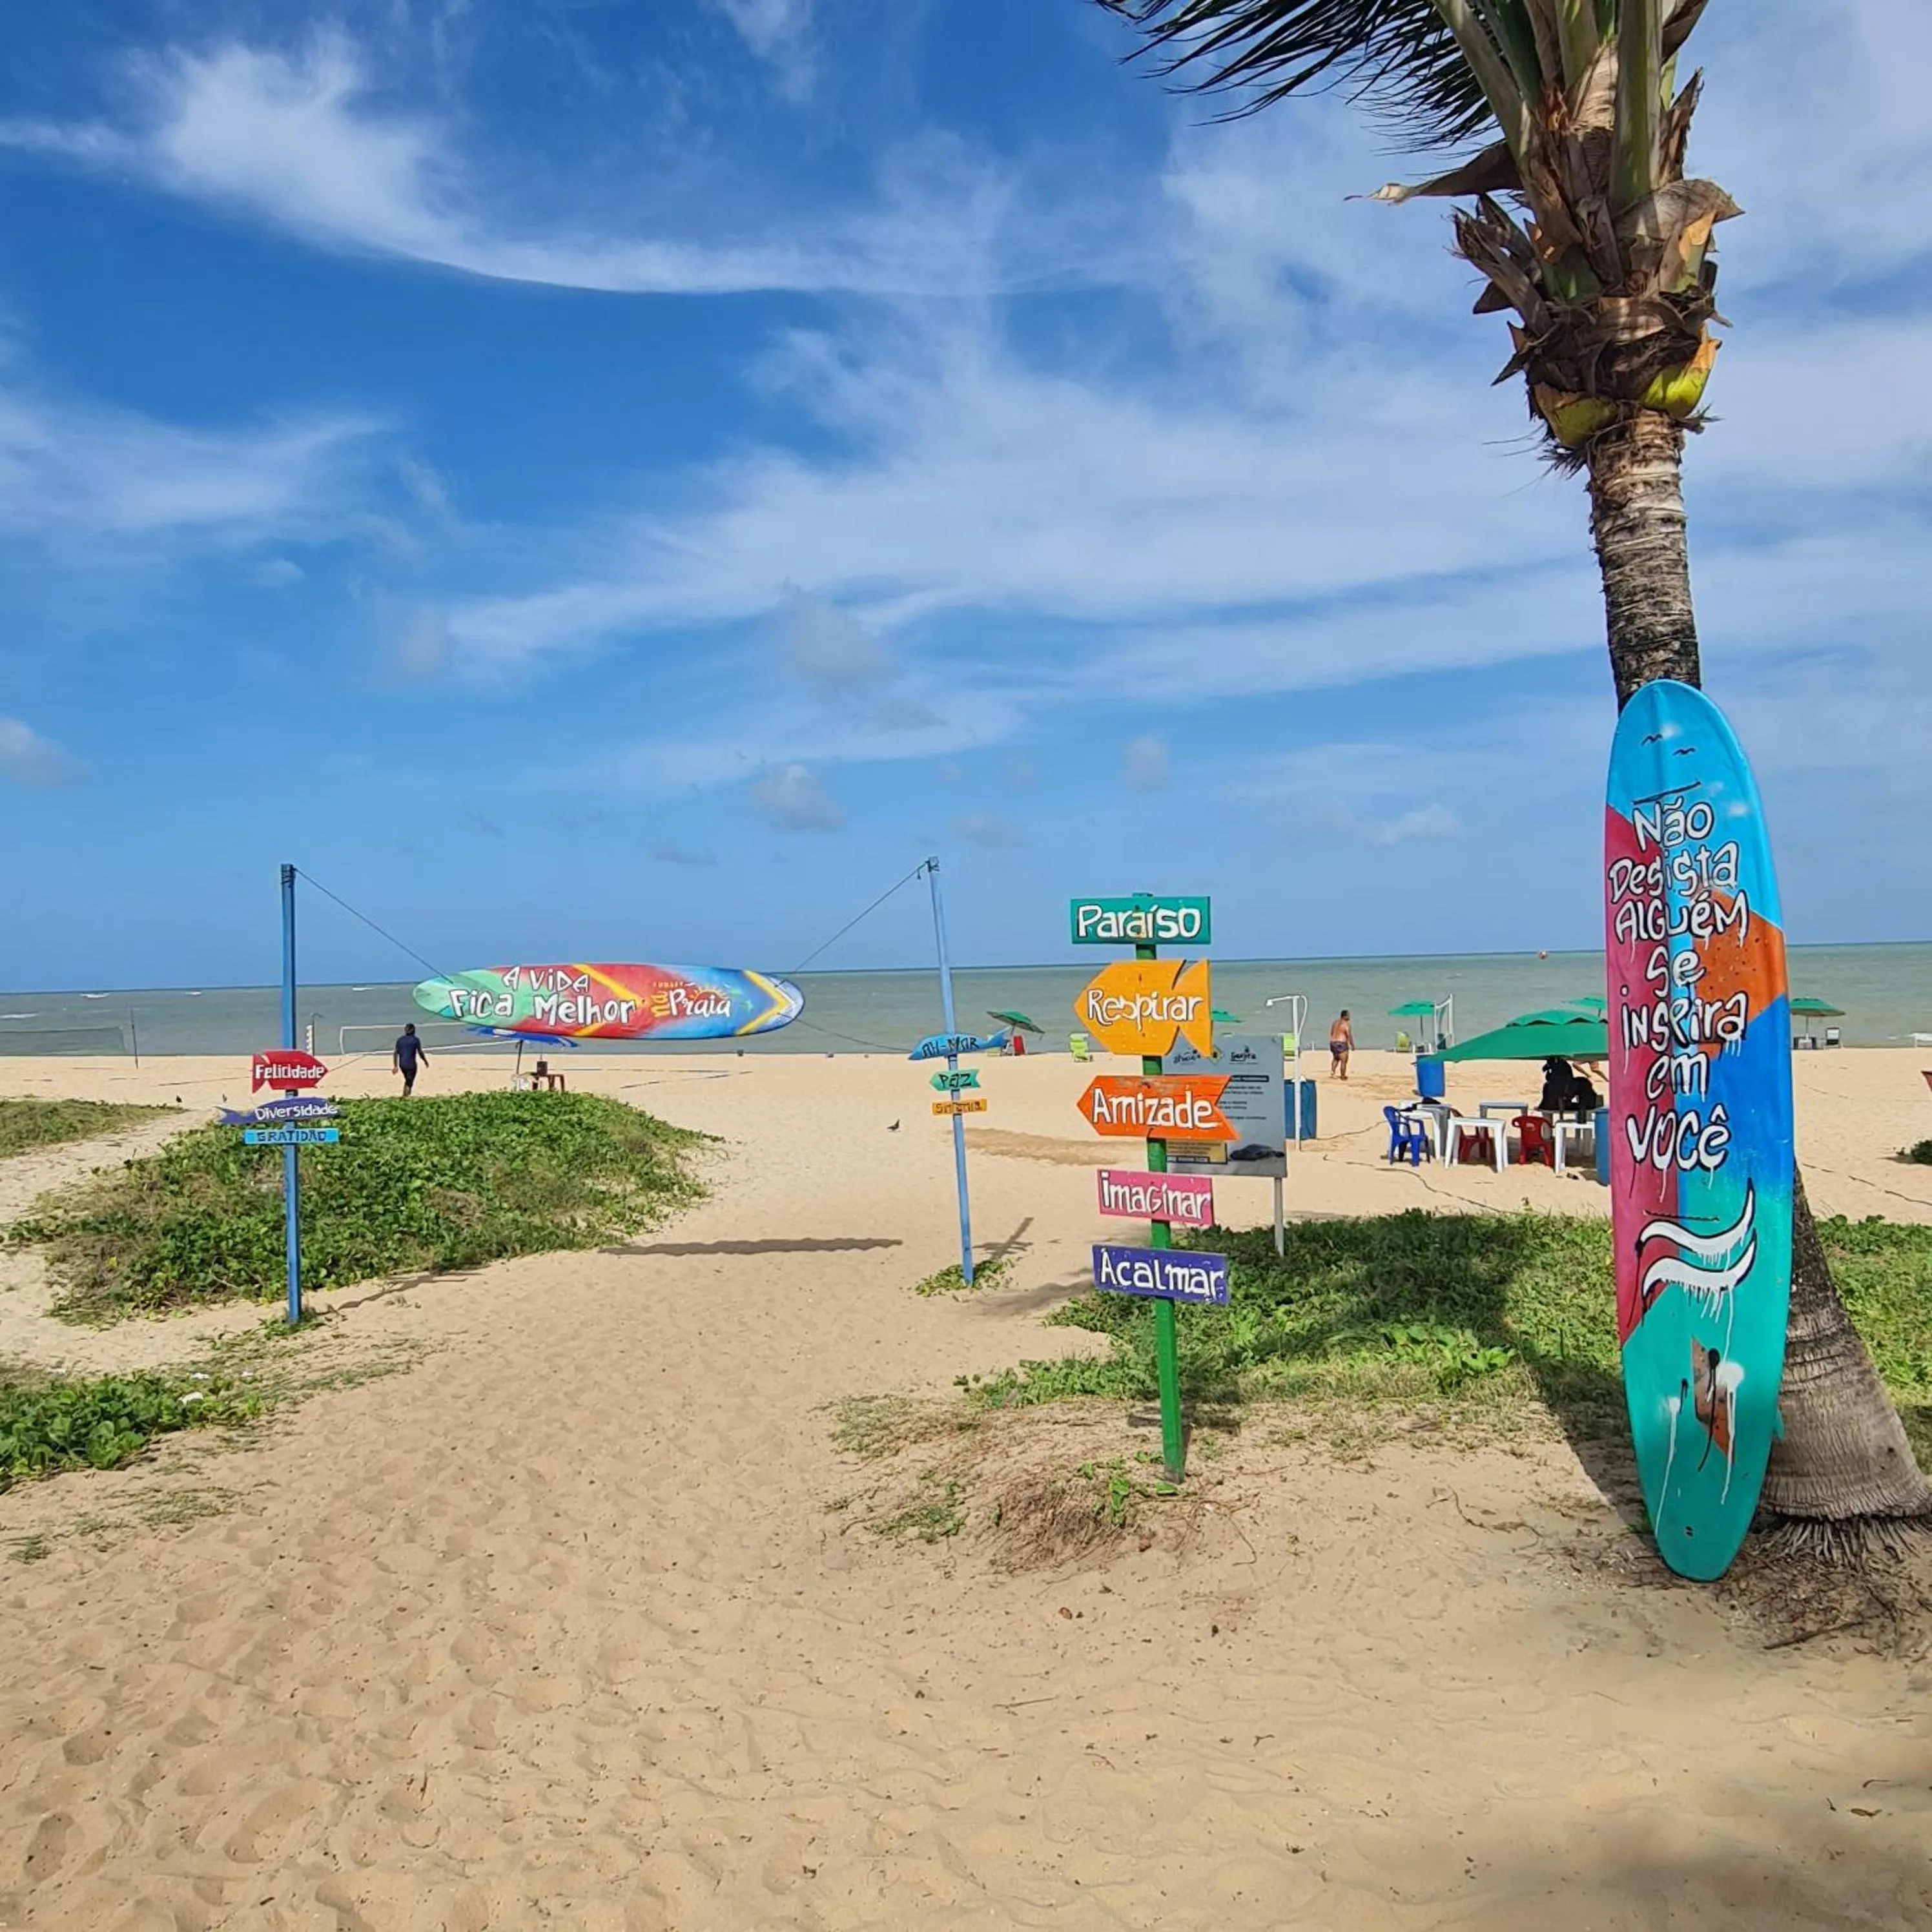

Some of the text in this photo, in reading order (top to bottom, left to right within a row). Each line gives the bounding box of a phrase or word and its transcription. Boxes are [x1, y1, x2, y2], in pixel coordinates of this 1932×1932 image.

[1632, 796, 1714, 852] Não
[1608, 841, 1739, 903] Desista
[1078, 904, 1202, 939] Paraíso
[501, 966, 520, 991] A
[533, 992, 636, 1027] Melhor
[669, 988, 732, 1018] Praia
[1087, 989, 1204, 1032] Respirar
[255, 1064, 325, 1080] Felicidade
[1647, 1051, 1710, 1100] em
[254, 1102, 338, 1121] Diversidade
[1093, 1087, 1219, 1129] Amizade
[1100, 1248, 1224, 1300] Acalmar
